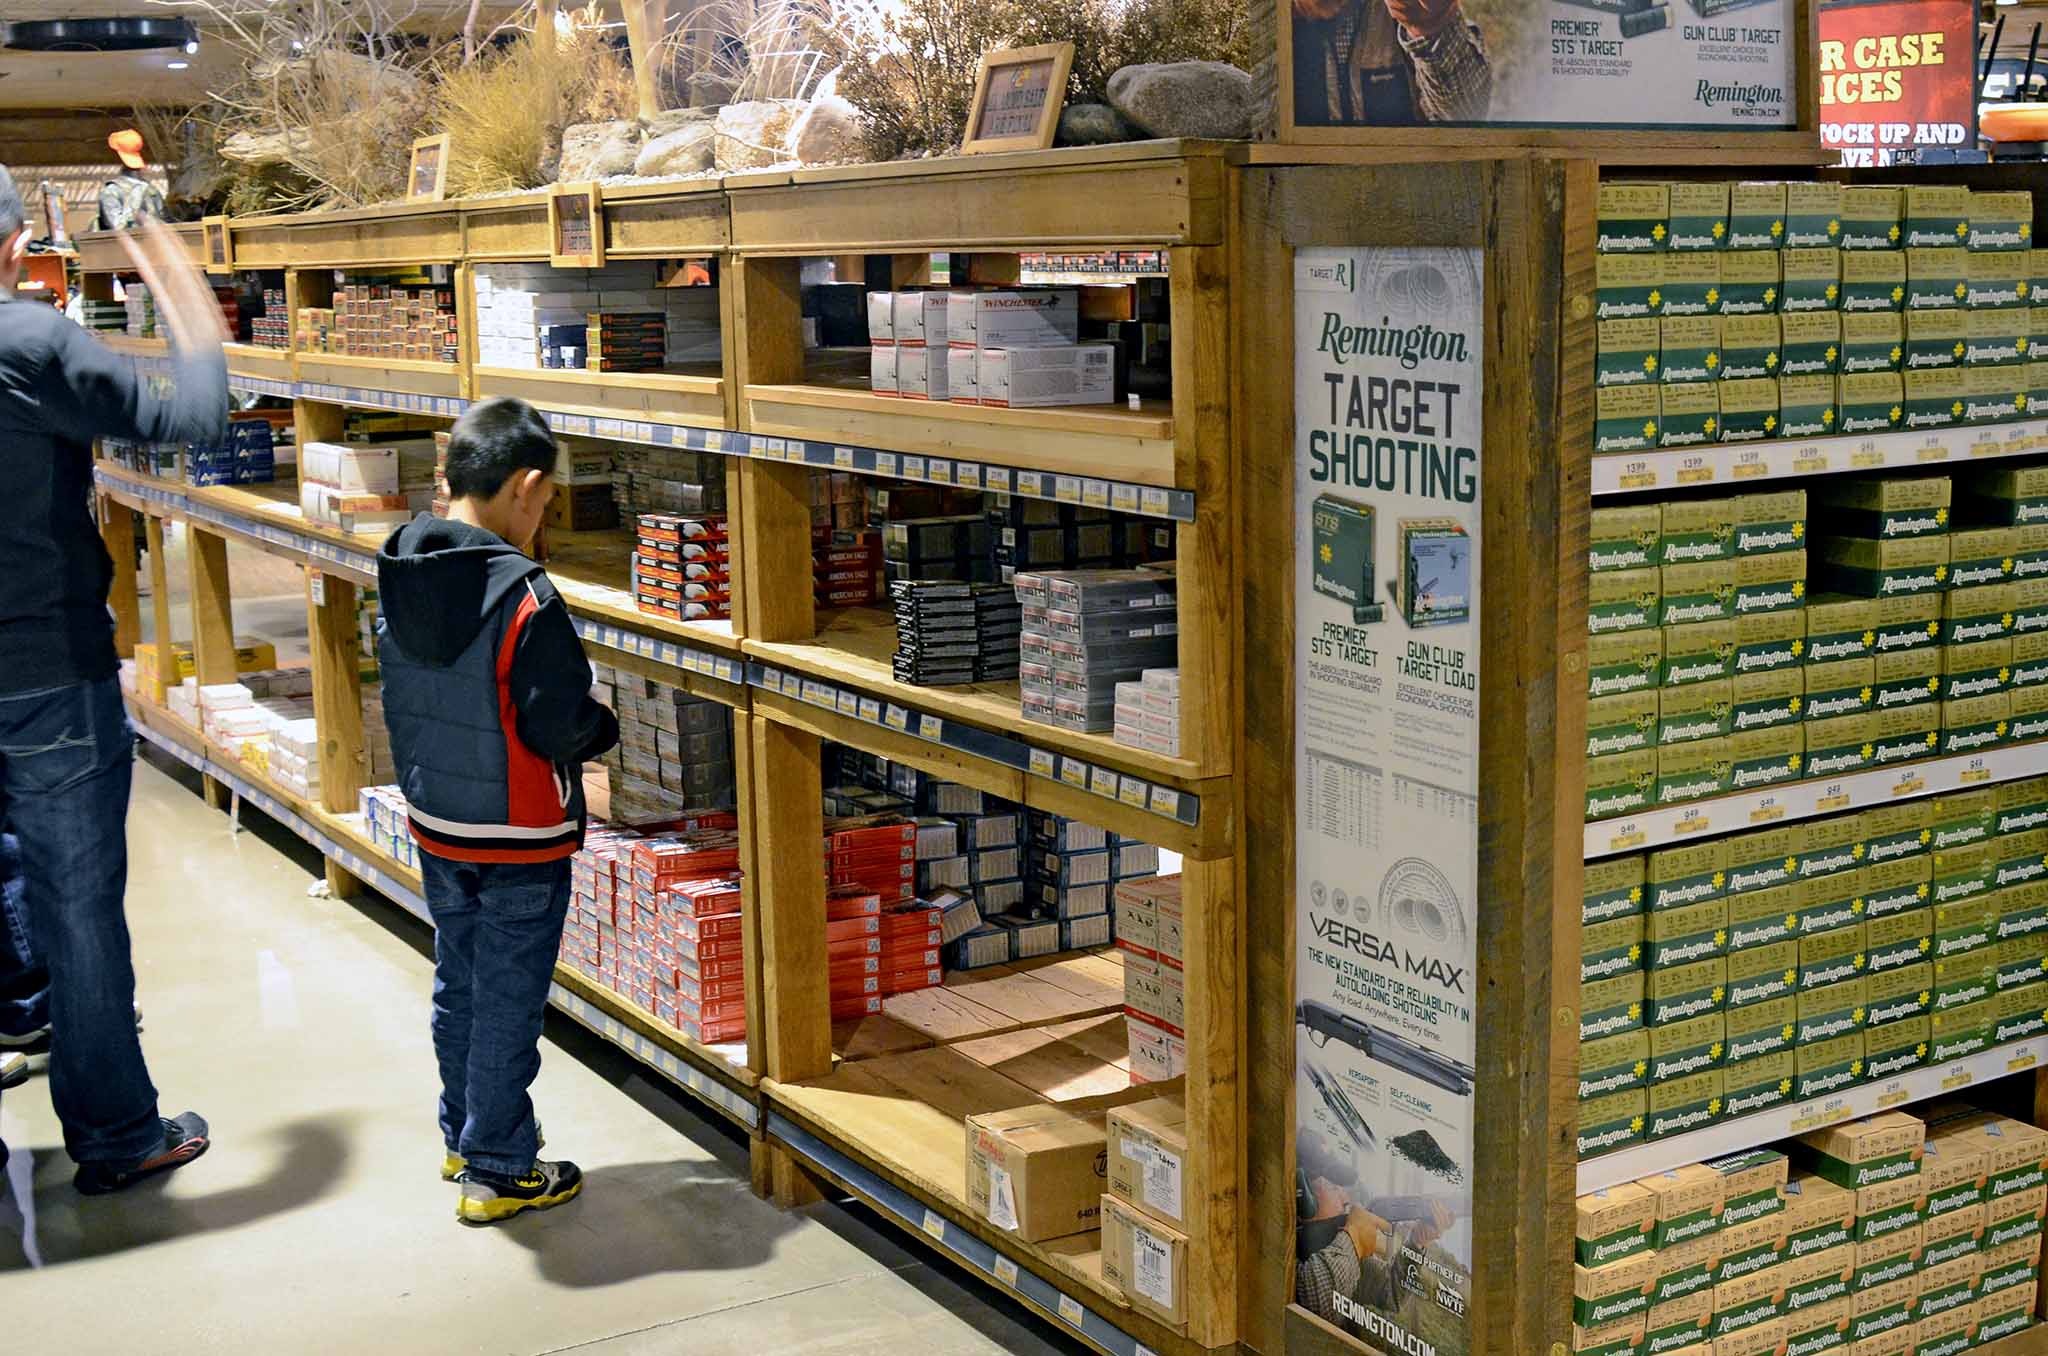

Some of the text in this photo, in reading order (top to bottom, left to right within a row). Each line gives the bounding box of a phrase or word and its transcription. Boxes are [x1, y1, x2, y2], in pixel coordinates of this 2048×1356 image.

[1551, 20, 1599, 37] PREMIER
[1684, 26, 1781, 44] GUN CLUB TARGET
[1552, 40, 1624, 57] STS TARGET
[1854, 32, 1944, 69] CASE
[1552, 58, 1632, 68] THE ABSOLUTE STANDARD
[1561, 67, 1594, 76] SHOOTING
[1695, 79, 1783, 107] Remington
[1820, 71, 1902, 104] ICES
[1732, 108, 1780, 117] REMINGTON.COM
[1879, 123, 1911, 144] UP
[1913, 123, 1966, 144] AND
[1310, 268, 1334, 279] TARGET
[1317, 312, 1469, 370] Remington
[1324, 372, 1461, 439] TARGET
[1309, 430, 1476, 504] SHOOTING
[1885, 517, 1938, 536] Remington
[1664, 542, 1724, 561] Remington
[1738, 532, 1794, 551] Remington
[1882, 575, 1936, 593] Remington
[1952, 567, 2003, 585] Remington
[1664, 602, 1724, 622] Remington
[1736, 591, 1794, 611] Remington
[1588, 611, 1646, 632] Remington
[1323, 622, 1367, 647] PREMIER
[1877, 631, 1929, 648] Remington
[1312, 637, 1378, 668] STS TARGET
[1407, 641, 1463, 669] GUN CLUB
[1736, 648, 1793, 670] Remington
[1809, 640, 1864, 660] Remington
[1396, 656, 1475, 690] TARGET LOAD
[1668, 661, 1724, 683] Remington
[1398, 683, 1473, 706] EXCELLENT CHOICE FOR
[1440, 702, 1474, 719] SHOOTING
[1735, 707, 1791, 728] Remington
[1733, 763, 1791, 785] Remington
[1808, 754, 1864, 774] Remington
[1868, 838, 1921, 860] Remington
[1799, 854, 1854, 876] Remington
[1729, 868, 1787, 891] Remington
[1656, 883, 1715, 907] Remington
[1799, 909, 1854, 932] Remington
[1731, 925, 1787, 948] Remington
[1937, 932, 1988, 954] Remington
[1309, 911, 1465, 993] VERSA MAX
[1657, 940, 1717, 965] Remington
[1869, 948, 1921, 970] Remington
[1308, 947, 1470, 1023] THE NEW STANDARD FOR RELIABILITY IN
[1801, 964, 1856, 987] Remington
[1335, 974, 1437, 1025] AUTOLOADING SHOTGUNS
[1731, 980, 1786, 1004] Remington
[1332, 989, 1442, 1042] Any load. Anywhere. Every time.
[1656, 997, 1714, 1022] Remington
[1729, 1035, 1784, 1060] Remington
[1654, 1053, 1712, 1079] Remington
[1578, 1070, 1636, 1096] Remington
[1800, 1072, 1853, 1095] Remington
[1727, 1090, 1782, 1114] Remington
[1652, 1109, 1711, 1135] Remington
[1856, 1160, 1915, 1184] Remington
[1993, 1170, 2043, 1195] Remington
[1722, 1197, 1779, 1224] Remington
[1928, 1190, 1979, 1214] Remington
[1665, 1217, 1716, 1242] Remington
[1864, 1211, 1918, 1236] Remington
[1991, 1220, 2038, 1245] Remington
[1593, 1234, 1645, 1259] Remington
[1924, 1240, 1977, 1265] Remington
[1401, 1246, 1422, 1265] PROUD
[1423, 1257, 1453, 1280] PARTNER
[1720, 1251, 1778, 1278] Remington
[1661, 1272, 1711, 1298] Remington
[1436, 1288, 1465, 1314] NWTF
[1592, 1296, 1646, 1320] Remington
[1920, 1289, 1972, 1314] Remington
[1333, 1290, 1436, 1356] REMINGTON.COM
[1718, 1304, 1776, 1332] Remington
[1856, 1311, 1910, 1337] Remington
[1650, 1328, 1702, 1351] Remington
